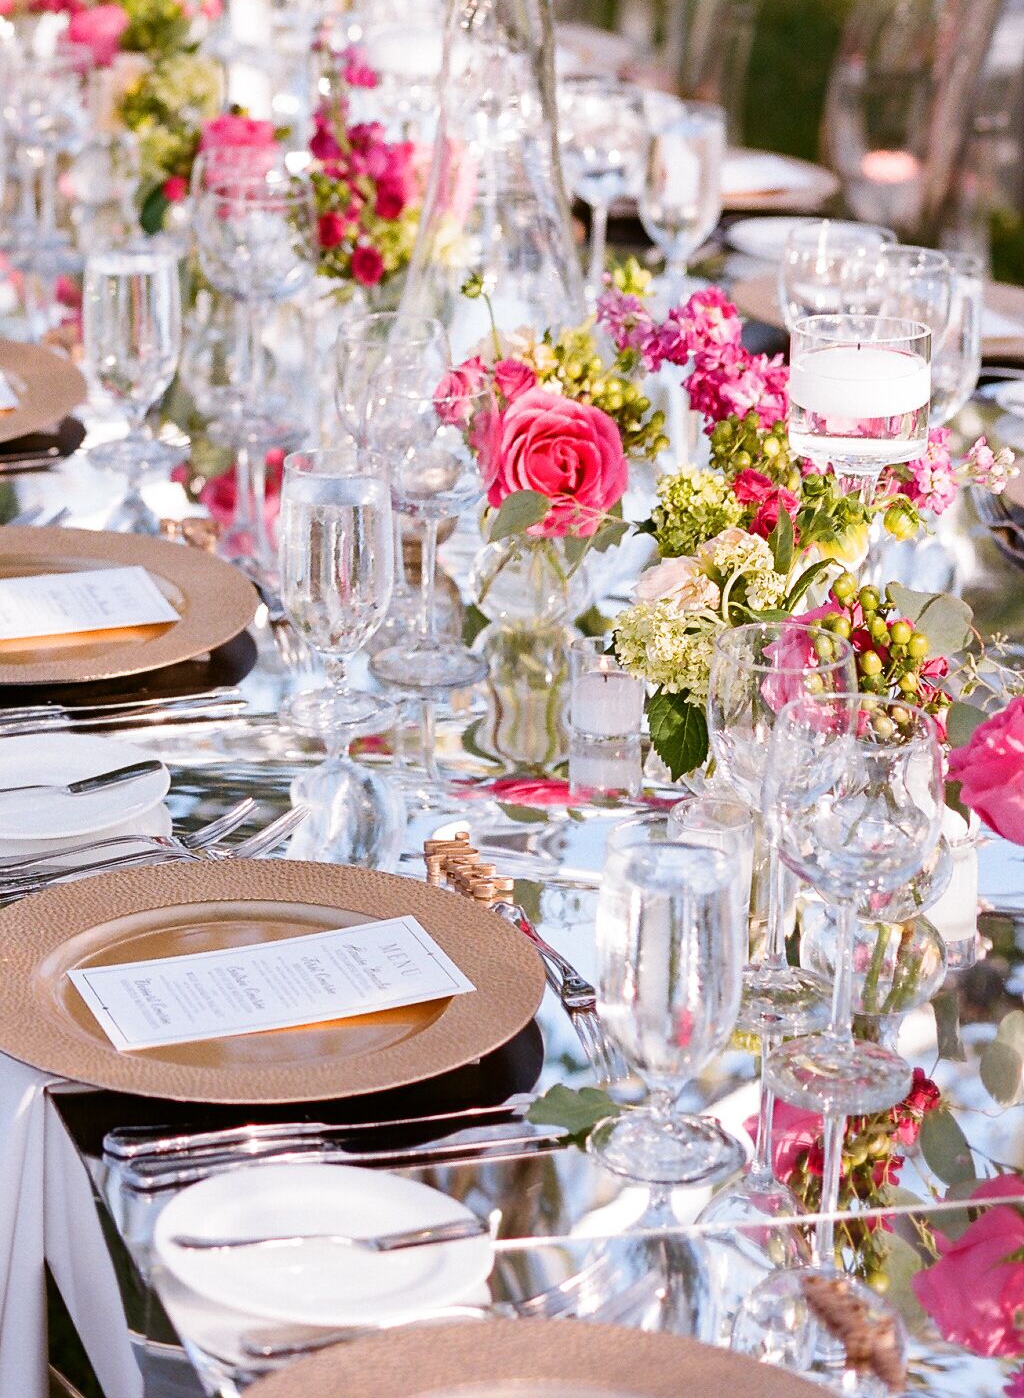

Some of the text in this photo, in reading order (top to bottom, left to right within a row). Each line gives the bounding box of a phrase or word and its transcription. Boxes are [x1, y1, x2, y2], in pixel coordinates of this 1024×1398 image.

[378, 943, 423, 977] MENU
[314, 973, 337, 995] Course
[243, 987, 266, 1010] Course
[151, 1002, 172, 1025] Course
